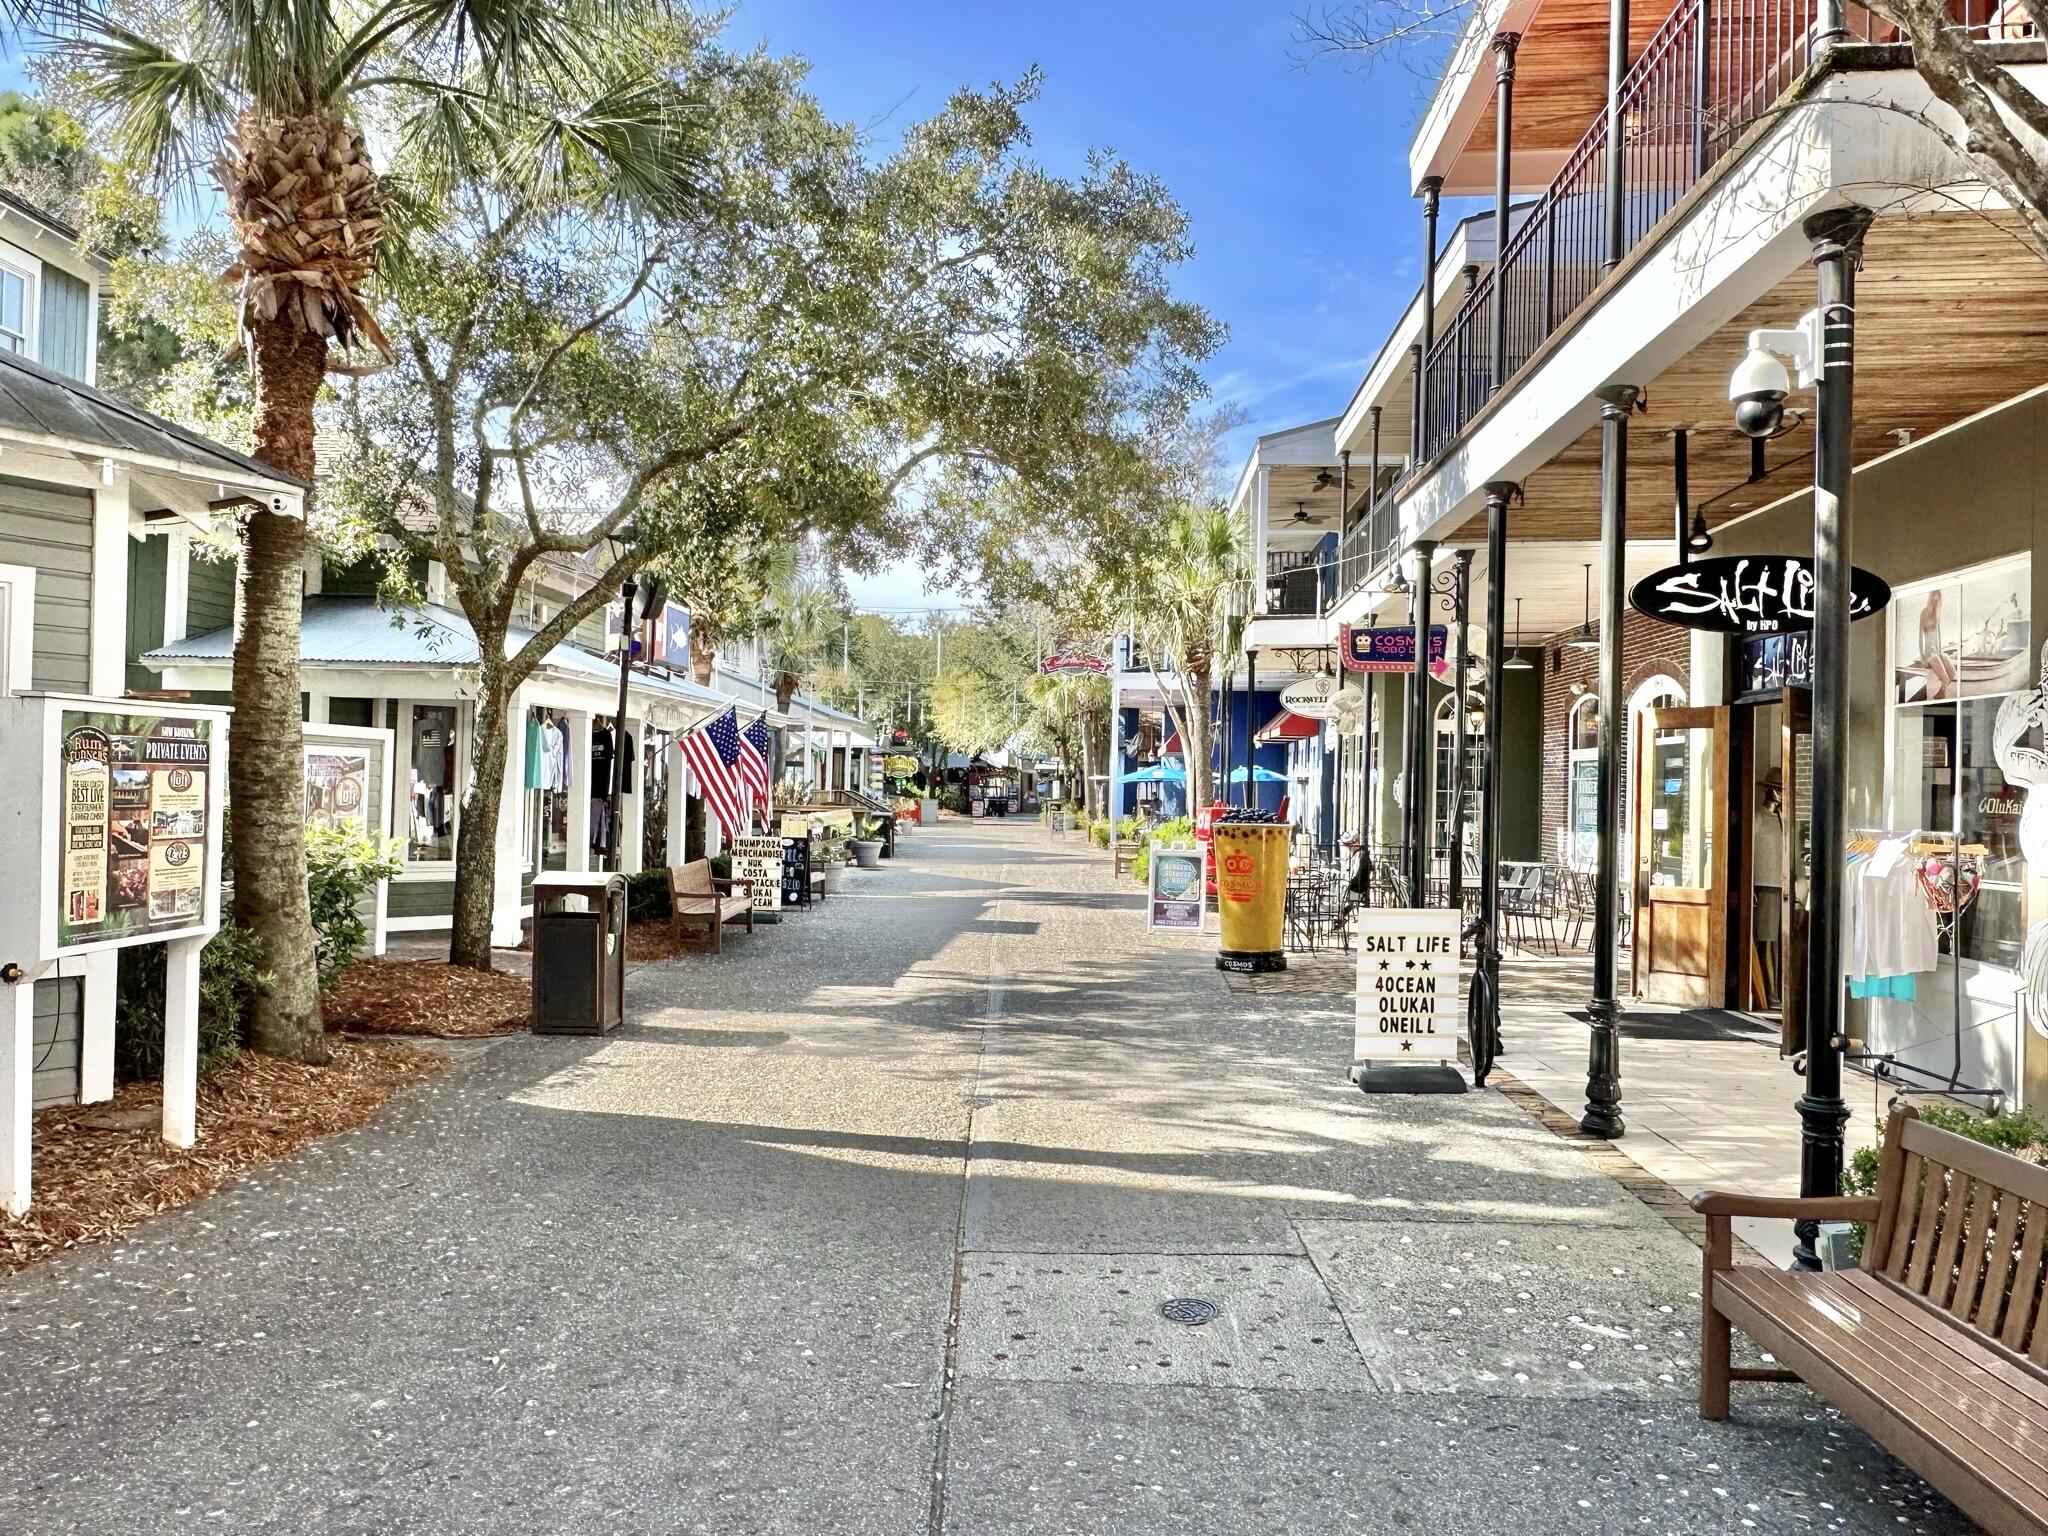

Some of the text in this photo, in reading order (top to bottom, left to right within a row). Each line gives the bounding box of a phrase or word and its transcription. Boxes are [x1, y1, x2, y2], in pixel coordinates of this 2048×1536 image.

[1777, 559, 1869, 618] Lie
[1746, 620, 1758, 632] by
[145, 742, 208, 760] PRIVATE EVENTS
[72, 788, 104, 802] BEST LIVE
[731, 849, 784, 859] MERCHANDISE
[743, 868, 768, 878] COSTA
[743, 888, 772, 897] OUKAI
[1366, 935, 1450, 953] SALT LIFE
[1375, 976, 1436, 993] 4OCEAN
[1379, 997, 1435, 1013] OLUKAI
[1379, 1017, 1435, 1033] ONEILL
